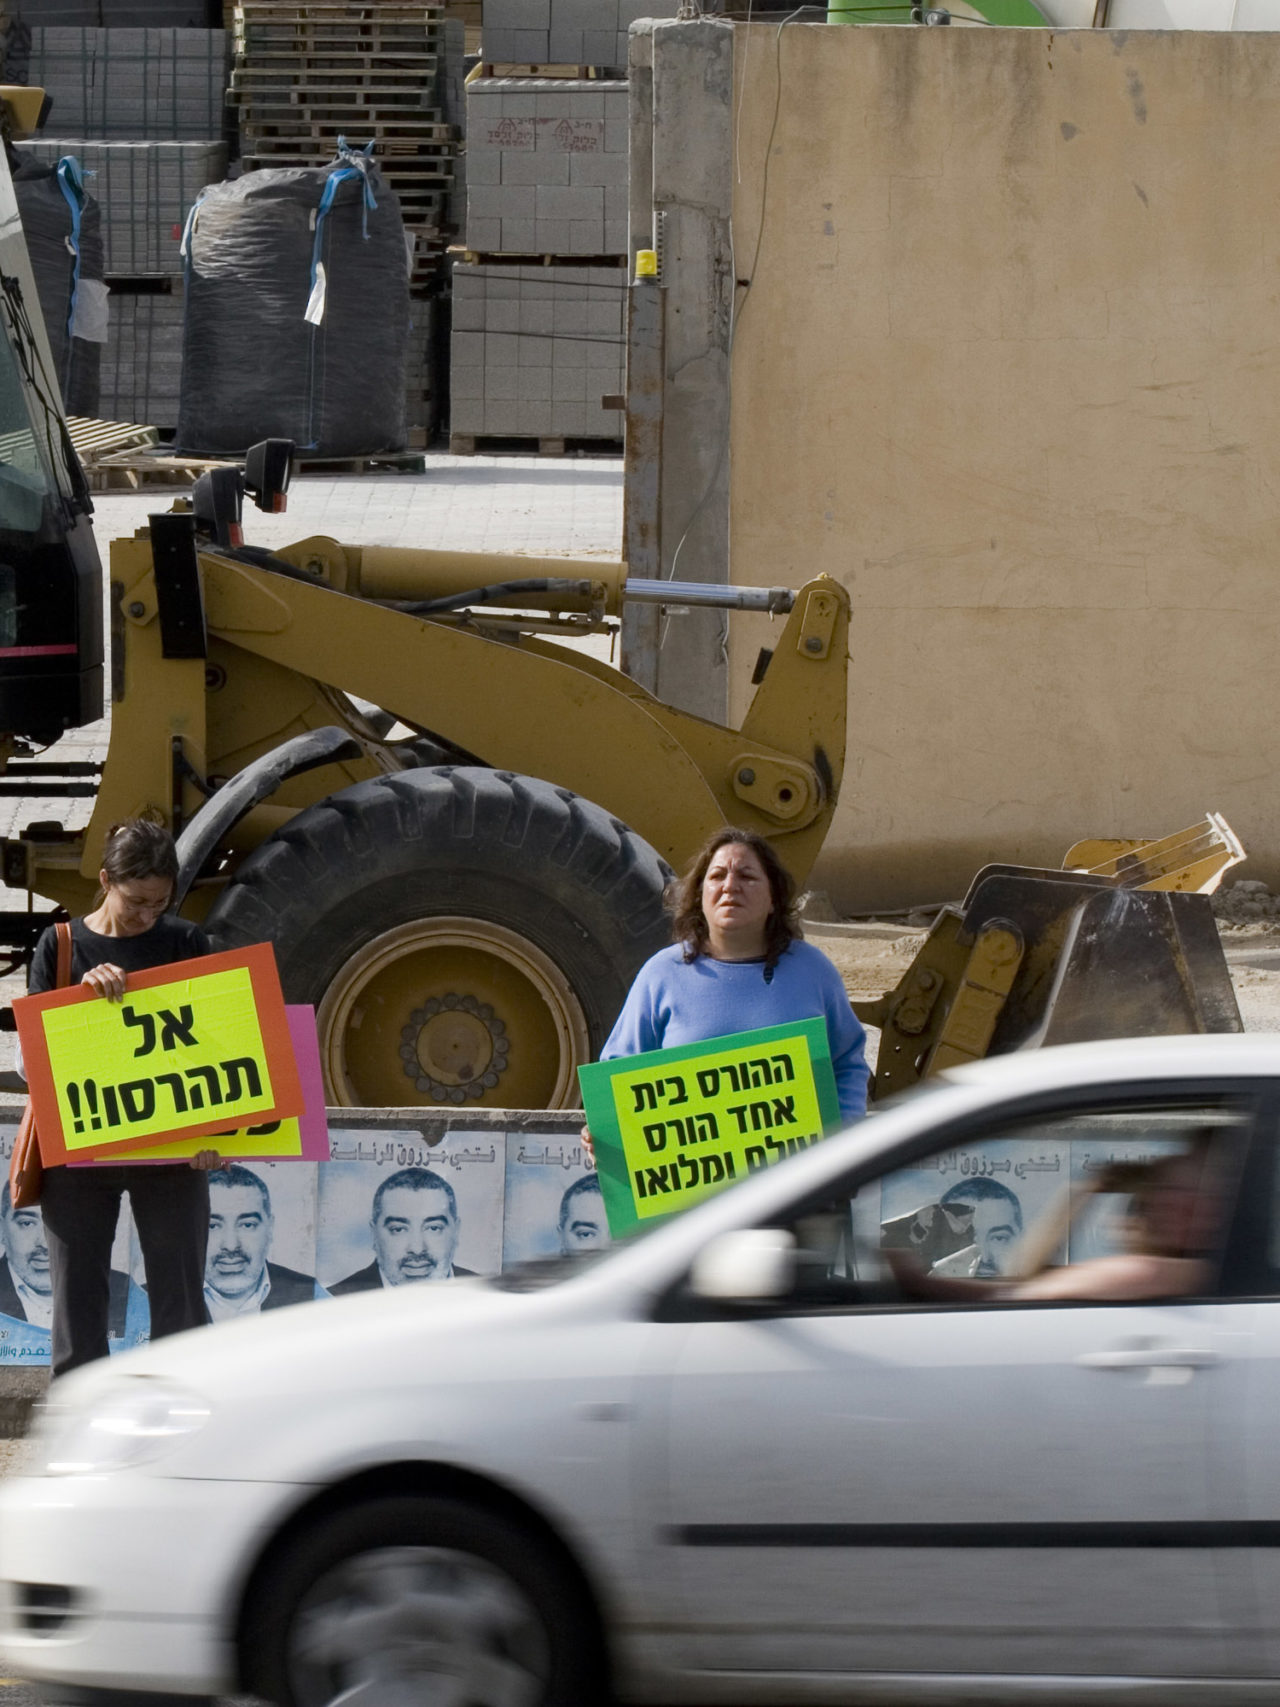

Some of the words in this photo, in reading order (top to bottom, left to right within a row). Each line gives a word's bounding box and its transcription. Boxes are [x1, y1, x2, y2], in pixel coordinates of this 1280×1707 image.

[121, 1004, 200, 1058] אל
[66, 1056, 263, 1134] תהרסו!!
[630, 1075, 689, 1113] בית
[696, 1053, 795, 1098] ההורס
[643, 1112, 720, 1153] הורס
[727, 1095, 798, 1134] אחד
[330, 1143, 394, 1166] للرئاسة
[450, 1145, 496, 1170] فتحي
[634, 1151, 736, 1198] ומלואו
